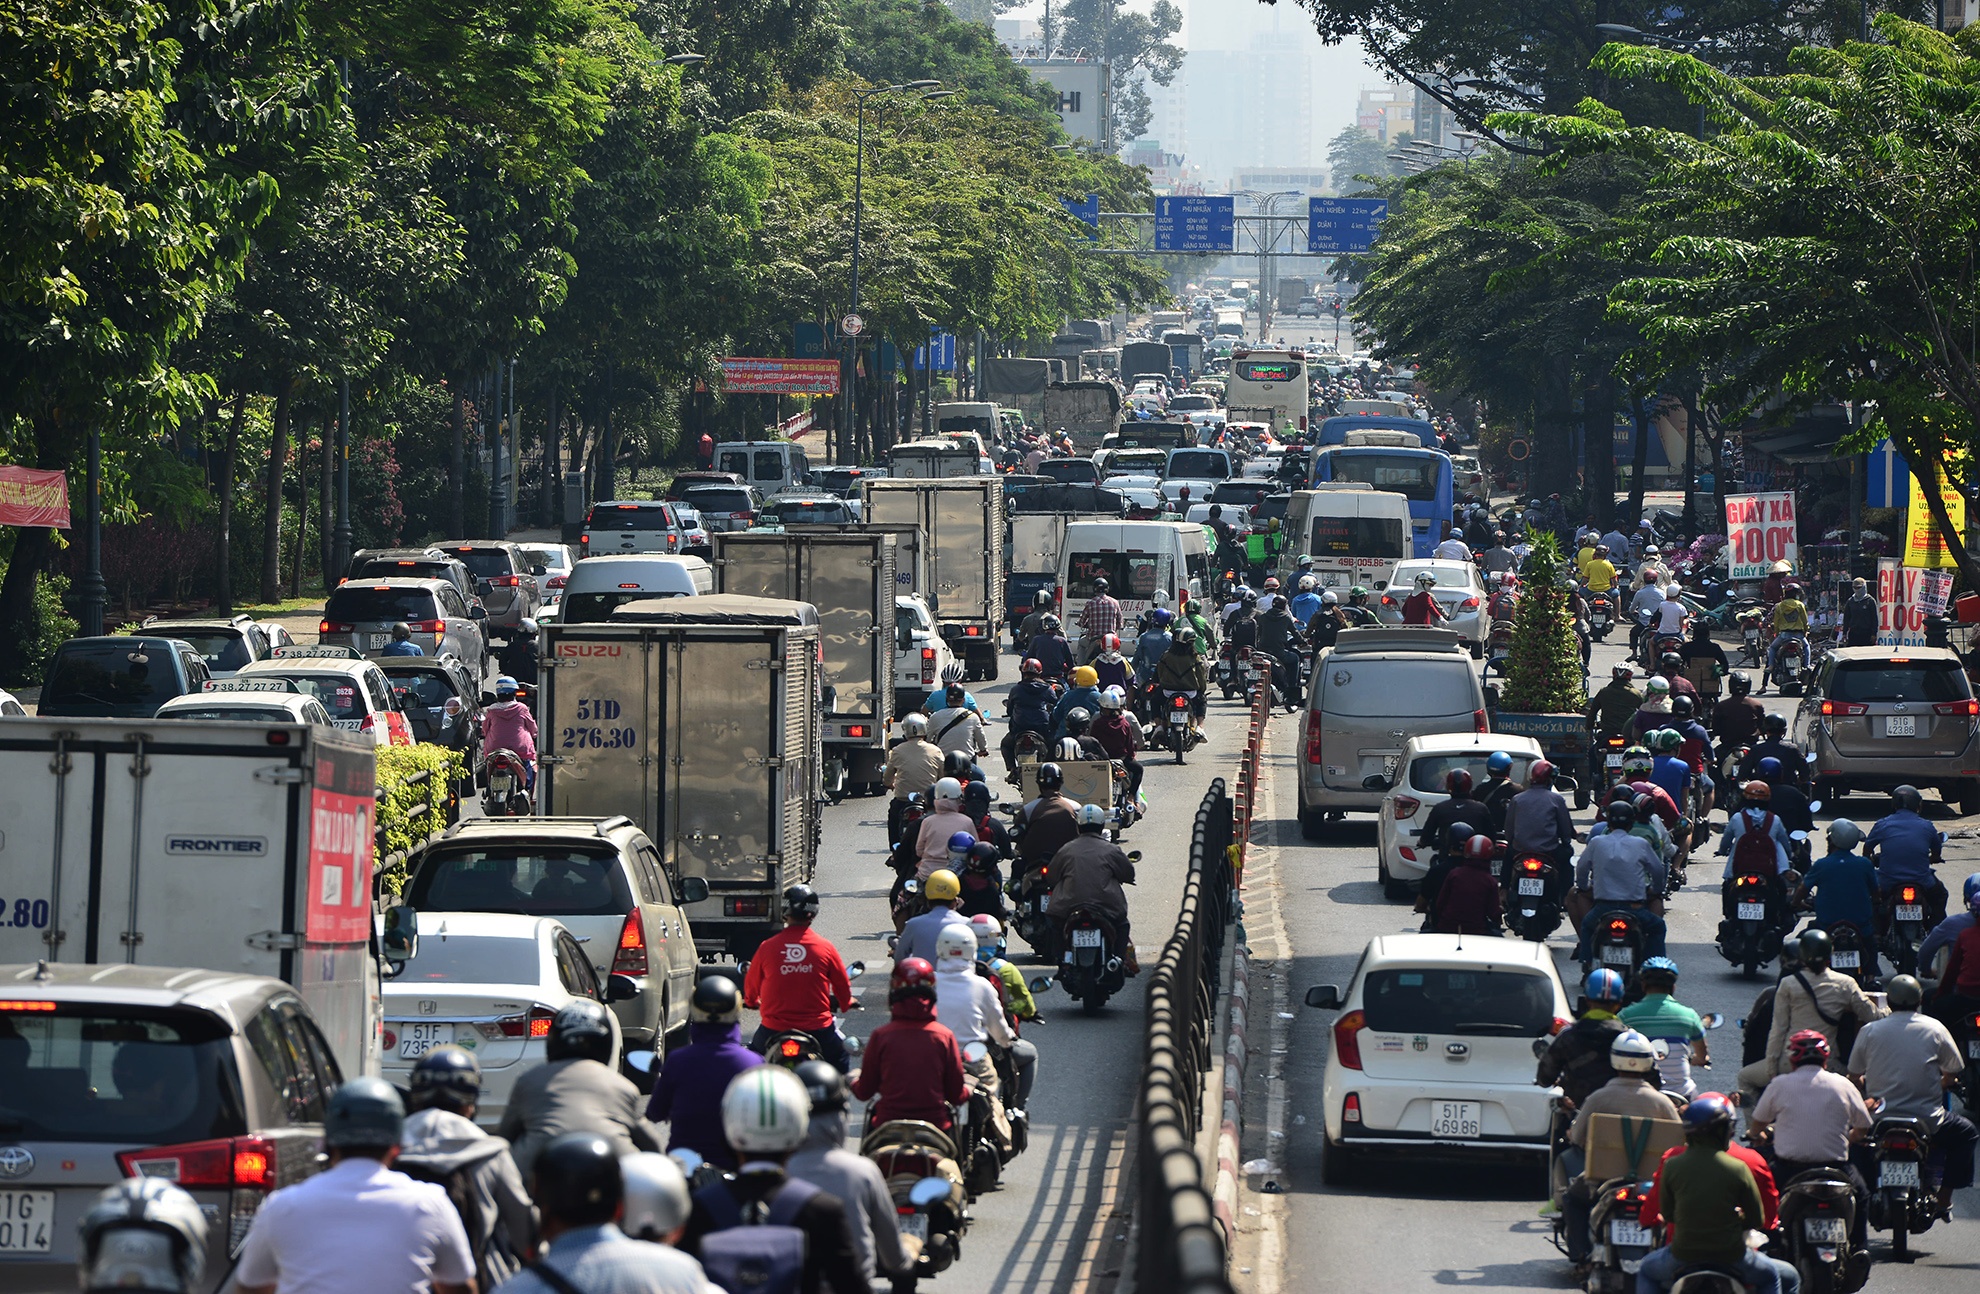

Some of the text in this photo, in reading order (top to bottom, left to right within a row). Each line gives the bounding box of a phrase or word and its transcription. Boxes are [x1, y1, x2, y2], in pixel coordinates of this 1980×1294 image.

[1943, 493, 1960, 501] NHA
[1769, 493, 1795, 522] XẢ
[1729, 526, 1796, 565] 100K
[1337, 557, 1384, 567] 49B-005.86
[321, 649, 334, 659] 27
[336, 649, 348, 658] 27
[557, 645, 622, 657] ISUZU
[254, 683, 267, 692] 27
[270, 682, 283, 691] 27
[577, 698, 621, 720] 51D
[348, 720, 361, 730] 27
[1893, 717, 1909, 726] 51G
[562, 726, 636, 749] 276.30
[170, 838, 263, 853] FRONTIER
[779, 963, 814, 976] goviet
[413, 1024, 442, 1040] 51F
[1442, 1104, 1468, 1119] 51F
[1432, 1118, 1479, 1136] 469.86
